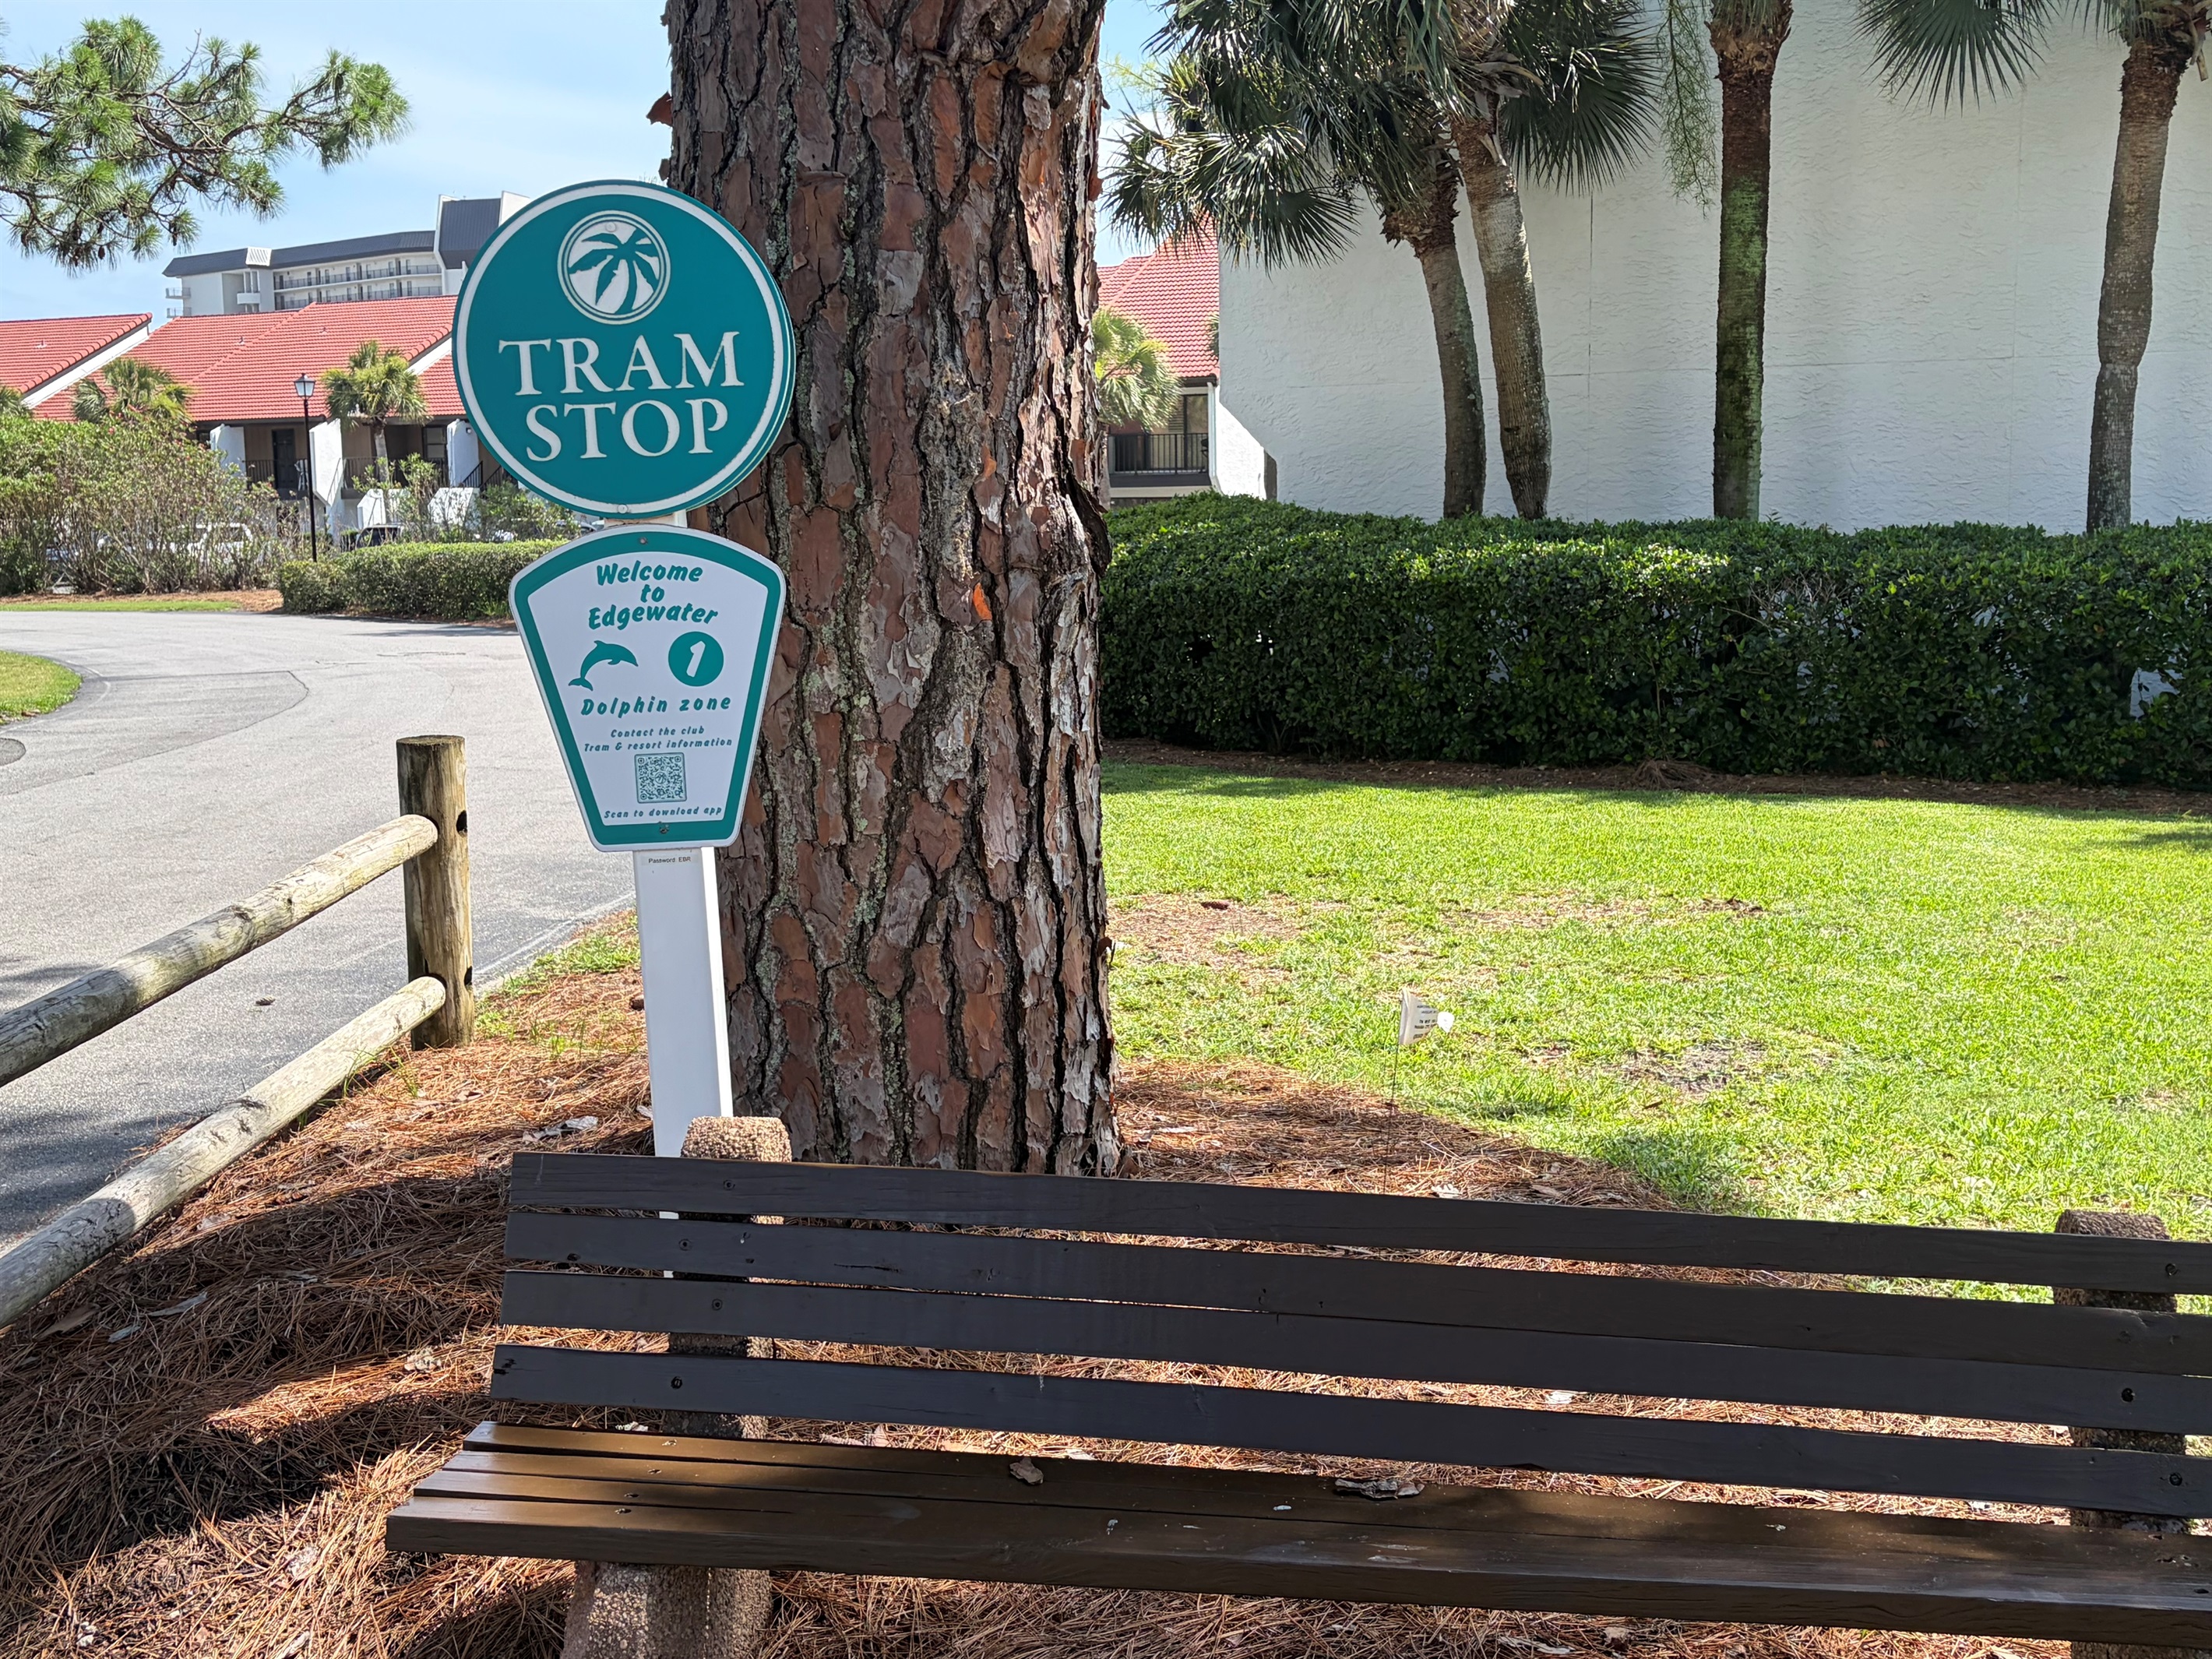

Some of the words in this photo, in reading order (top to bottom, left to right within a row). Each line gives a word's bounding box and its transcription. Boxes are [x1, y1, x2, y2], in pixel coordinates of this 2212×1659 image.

[498, 331, 745, 396] TRAM
[525, 398, 728, 462] STOP
[597, 560, 703, 586] Welcome
[640, 584, 665, 603] to
[588, 603, 718, 630] Edgewater
[685, 640, 706, 678] 1
[580, 696, 667, 718] Dolphin
[679, 697, 731, 711] zone
[611, 728, 653, 738] Contact
[659, 727, 676, 735] the
[681, 726, 705, 734] club
[584, 743, 609, 752] Tram
[615, 742, 622, 751] &
[627, 741, 662, 750] resort
[666, 738, 732, 748] information
[604, 810, 629, 819] Scan
[633, 809, 643, 818] to
[649, 806, 699, 816] download
[703, 807, 722, 815] app
